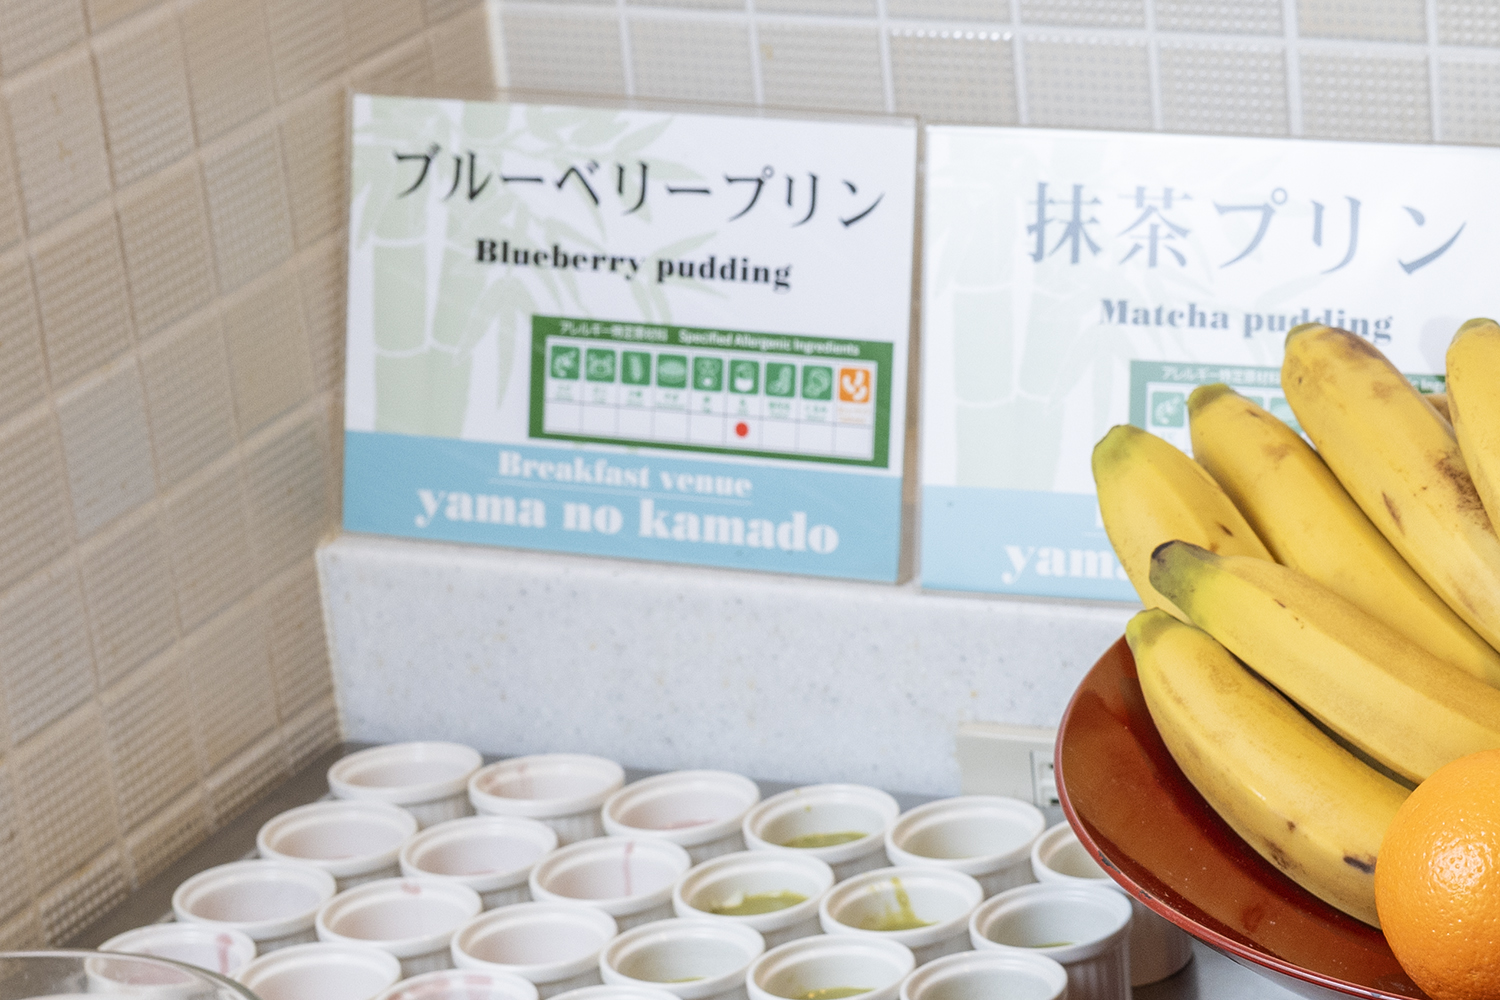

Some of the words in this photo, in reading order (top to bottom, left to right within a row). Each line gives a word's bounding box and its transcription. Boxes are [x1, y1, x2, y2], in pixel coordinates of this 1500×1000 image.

[393, 142, 886, 228] ブルーベリープリン
[1026, 182, 1466, 275] 抹茶プリン
[476, 239, 641, 281] Blueberry
[657, 253, 793, 291] pudding
[1101, 299, 1229, 329] Matcha
[500, 452, 649, 489] Breakfast
[660, 469, 752, 498] venue
[415, 488, 546, 529] yama
[563, 502, 623, 535] no
[639, 498, 839, 554] kamado
